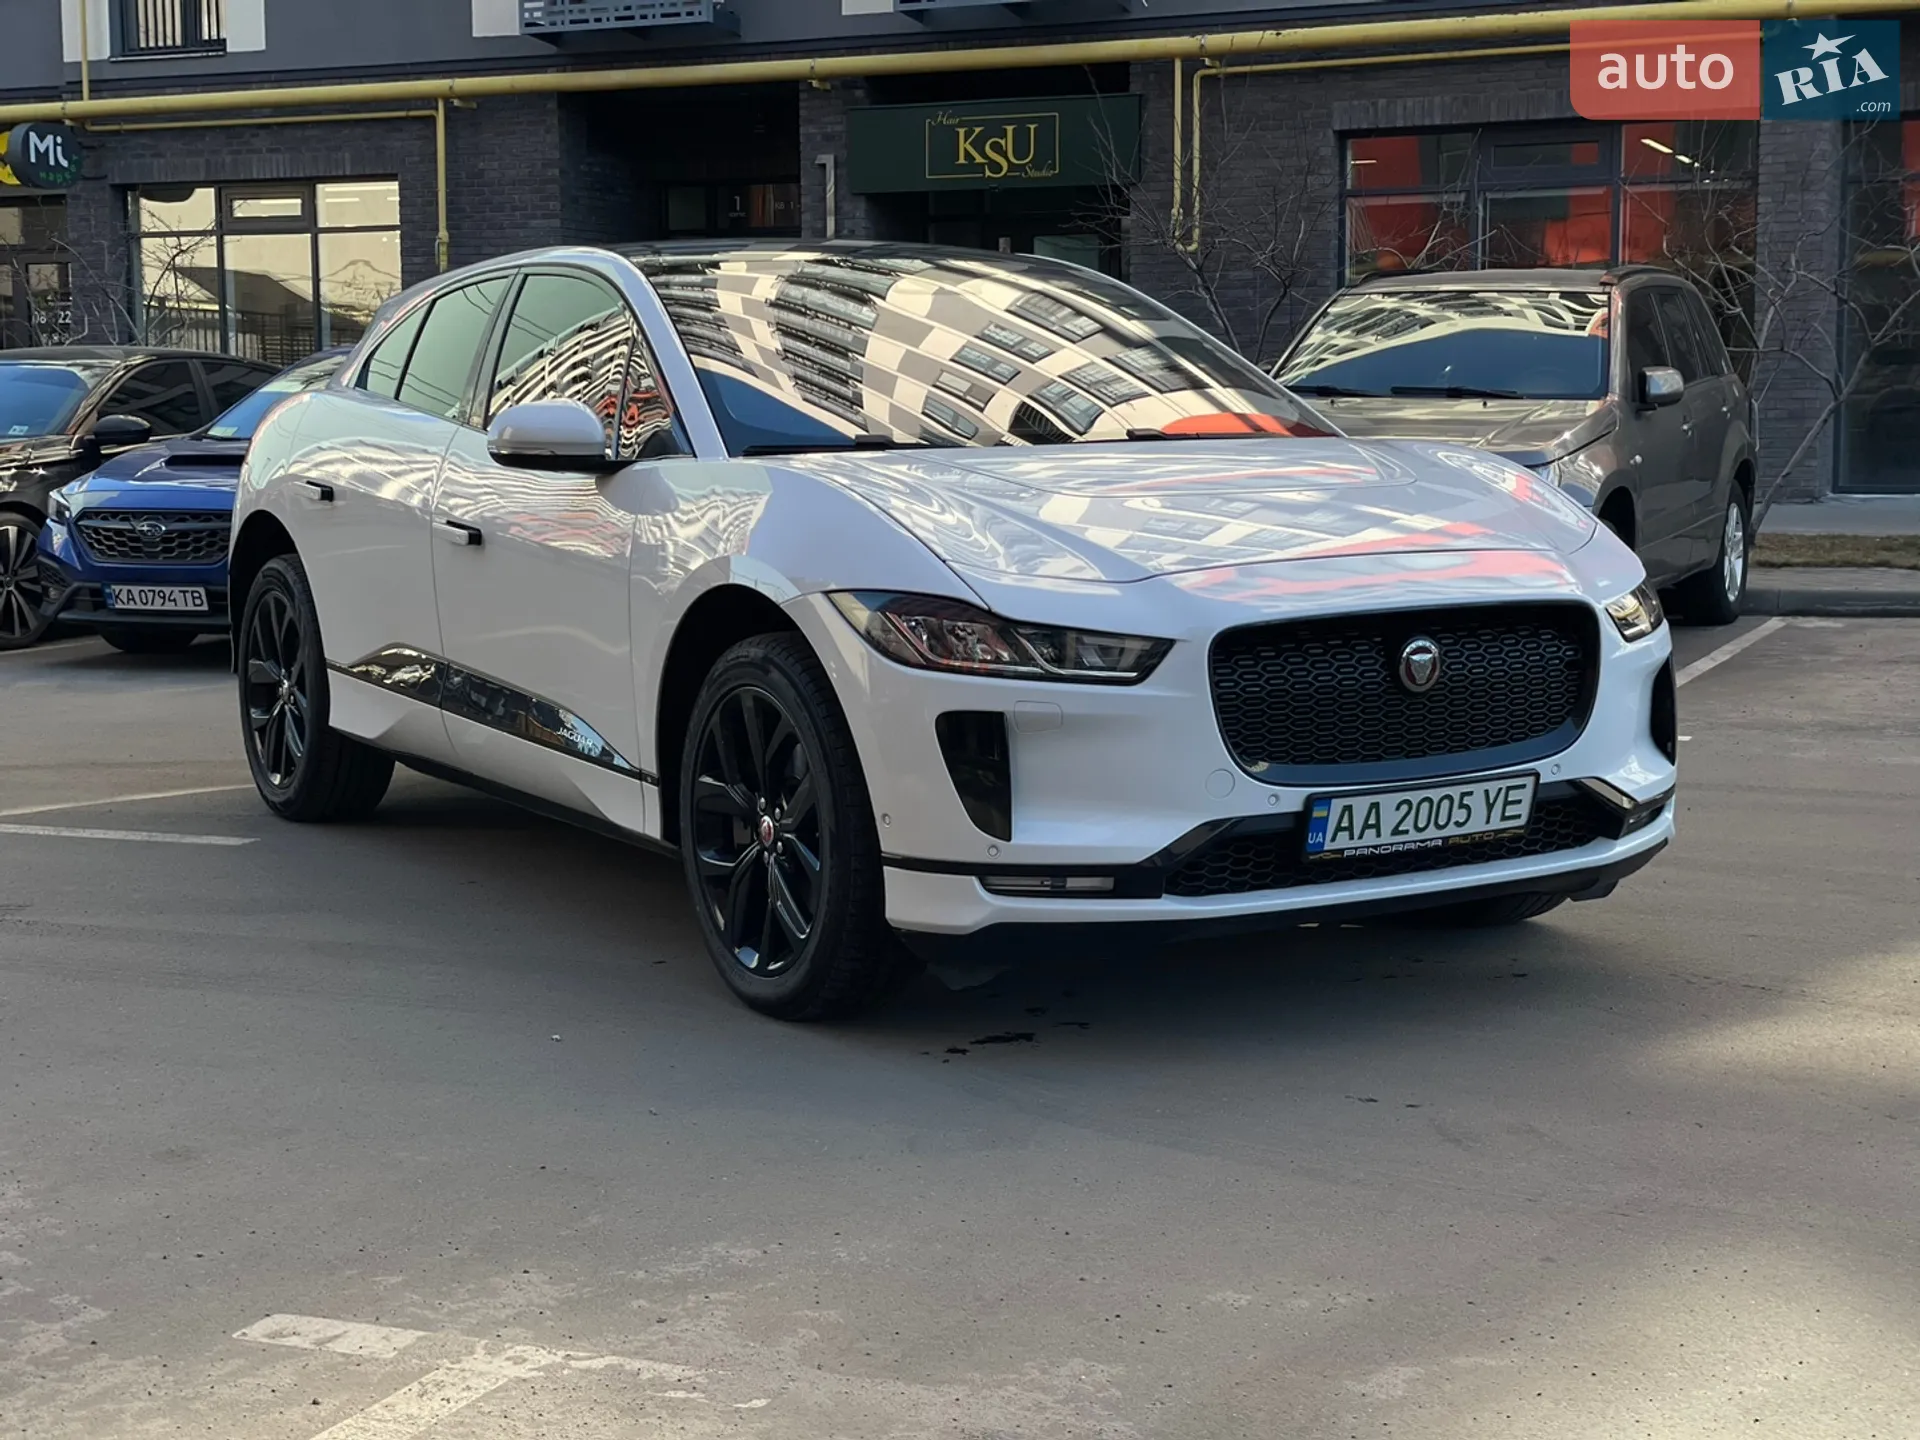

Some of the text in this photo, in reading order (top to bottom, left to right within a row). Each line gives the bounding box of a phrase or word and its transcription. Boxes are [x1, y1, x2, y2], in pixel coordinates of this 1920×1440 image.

[58, 310, 72, 324] 22
[556, 727, 594, 746] JAGUAR
[1307, 832, 1324, 844] UA
[1343, 832, 1495, 858] PANORAMA AUTO
